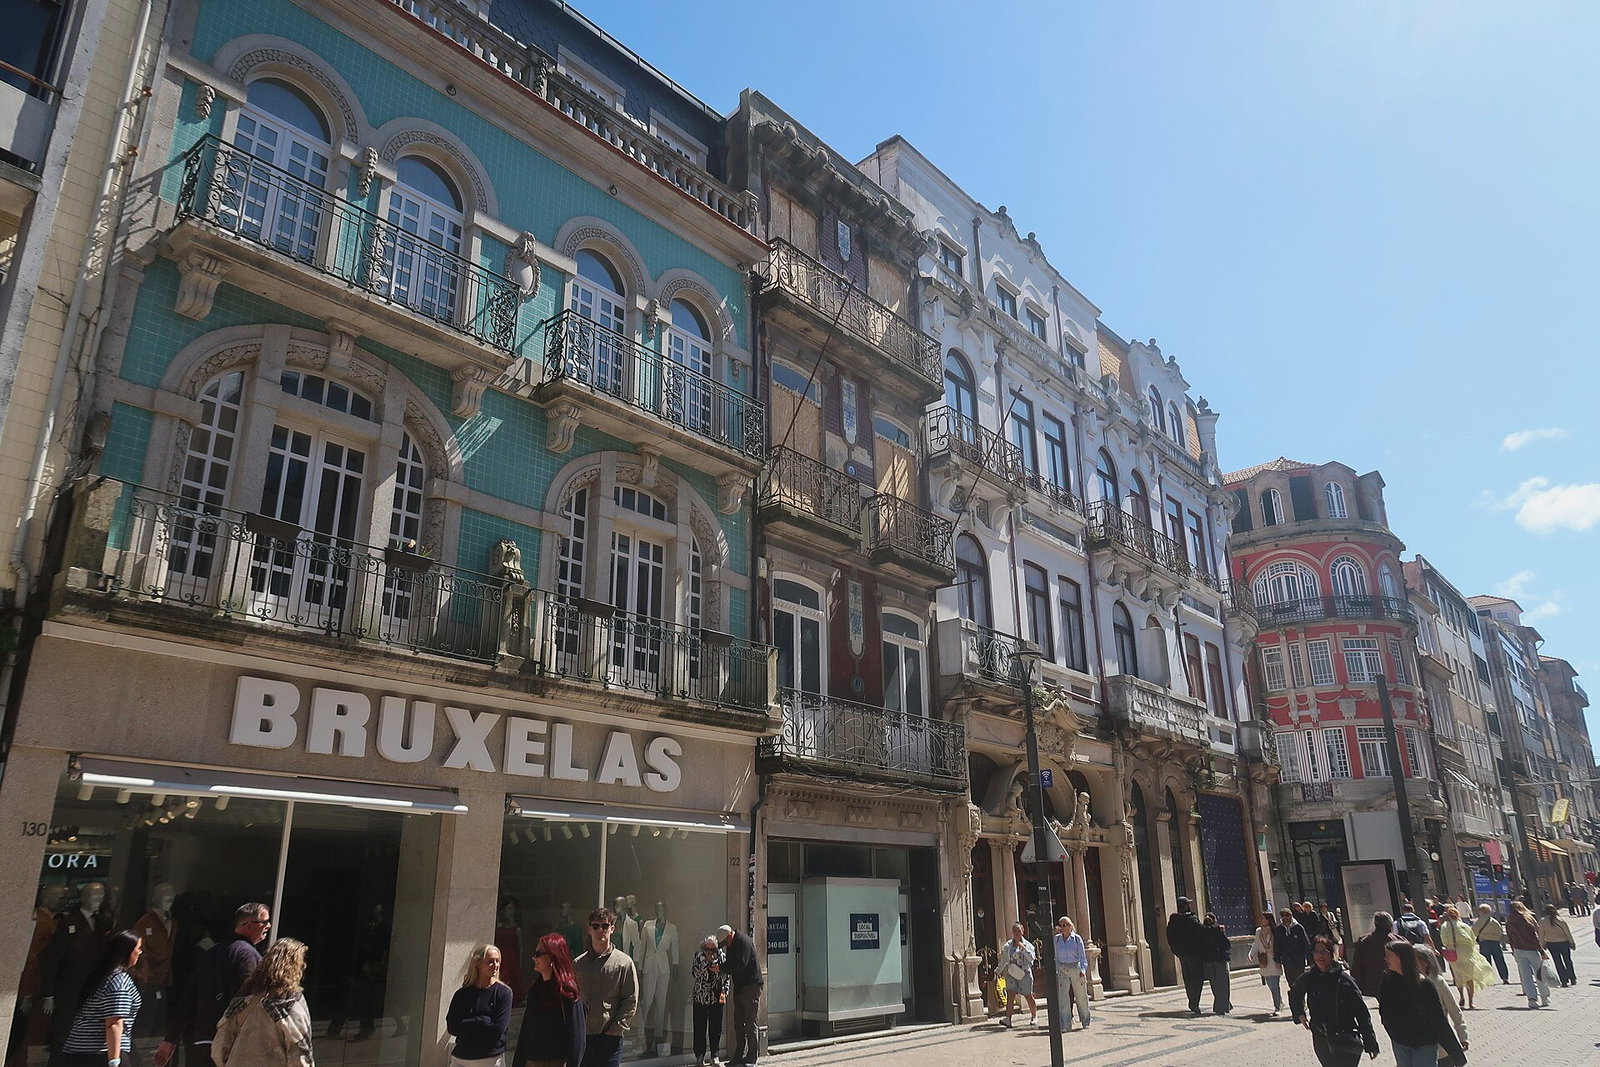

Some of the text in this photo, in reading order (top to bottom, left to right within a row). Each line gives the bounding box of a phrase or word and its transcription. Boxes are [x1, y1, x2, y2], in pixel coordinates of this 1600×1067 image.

[229, 675, 682, 793] BRUXELAS
[21, 822, 47, 836] 130
[48, 853, 97, 868] ORA
[730, 856, 740, 866] 122
